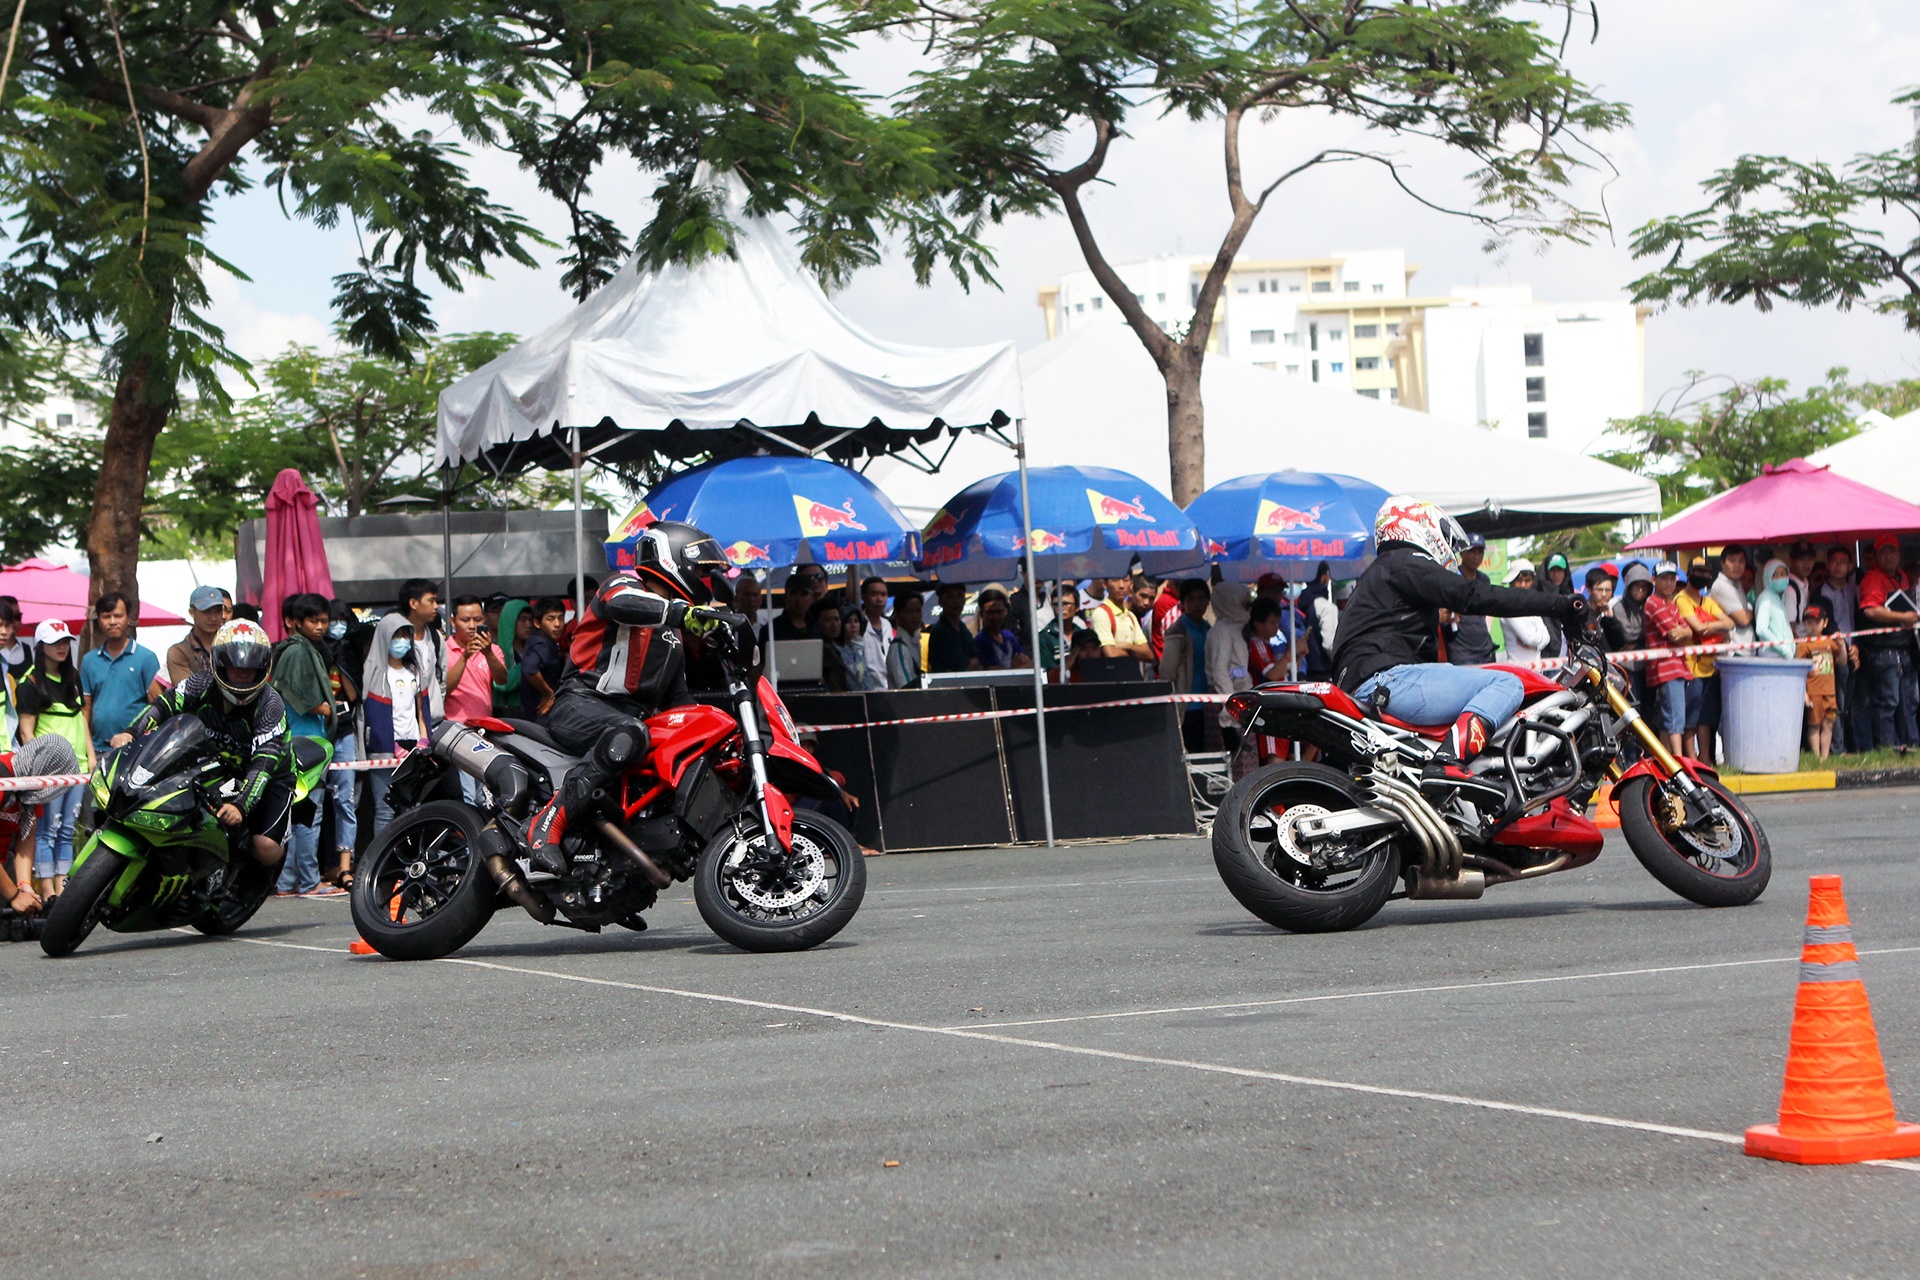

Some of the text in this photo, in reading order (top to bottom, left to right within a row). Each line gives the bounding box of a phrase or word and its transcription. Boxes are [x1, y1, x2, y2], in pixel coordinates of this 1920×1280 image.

[1116, 529, 1180, 546] Red Bull
[824, 540, 889, 561] Red Bull
[1275, 538, 1345, 556] Red Bull
[662, 558, 675, 571] BELL
[49, 623, 65, 632] W
[541, 805, 557, 832] DUCATI
